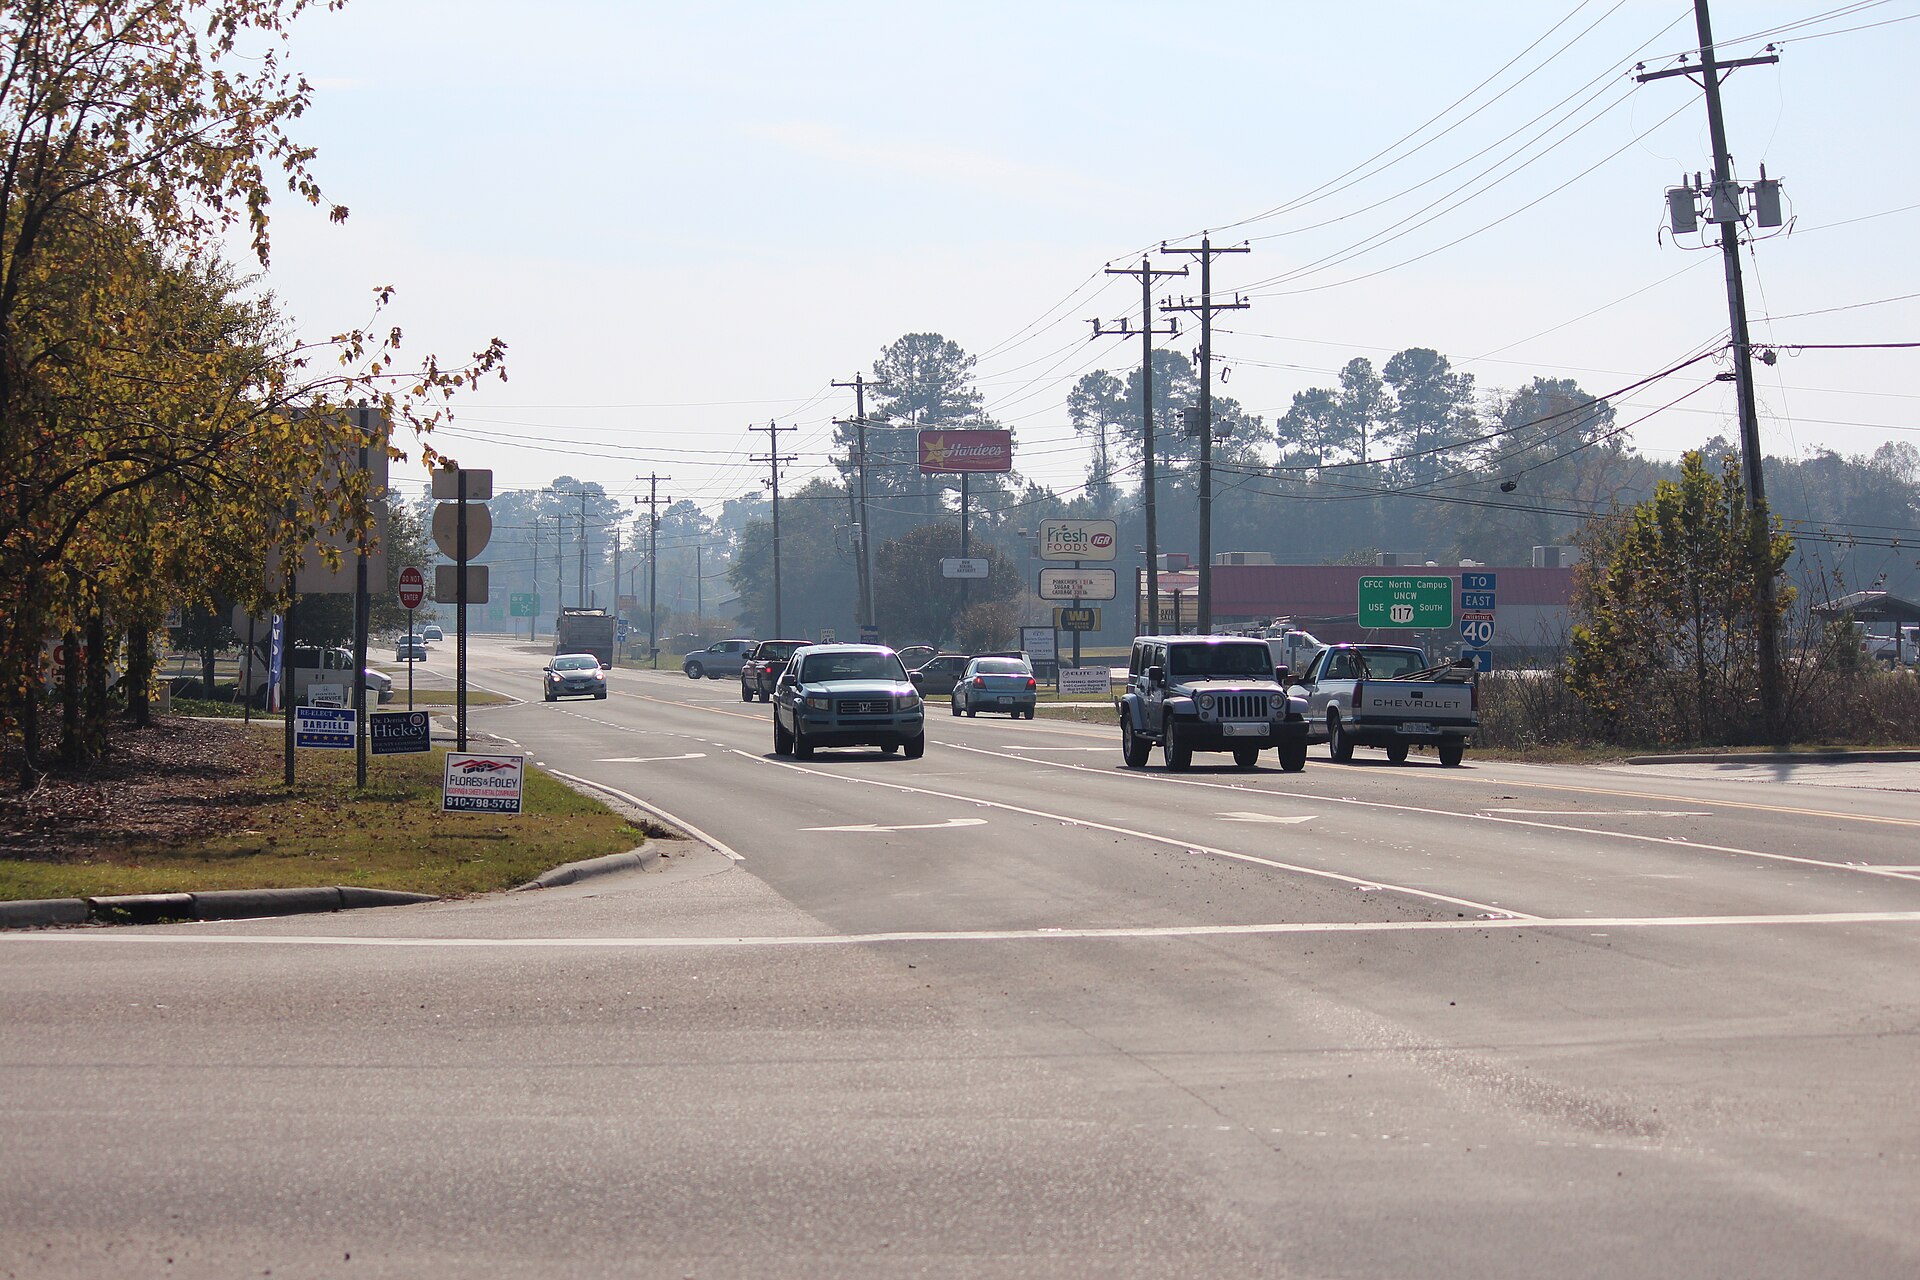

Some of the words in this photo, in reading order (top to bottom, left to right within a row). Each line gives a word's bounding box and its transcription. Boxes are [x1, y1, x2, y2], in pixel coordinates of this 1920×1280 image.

[1047, 527, 1088, 542] Fresh
[1093, 535, 1110, 545] IGA
[1047, 543, 1088, 551] FOODS
[1363, 580, 1384, 588] CFCC
[1388, 580, 1412, 588] North
[1416, 580, 1447, 590] Campus
[1470, 576, 1487, 587] TO
[1394, 592, 1417, 600] UNCW
[1465, 596, 1491, 606] EAST
[1069, 611, 1089, 621] WU
[1392, 607, 1412, 620] 117
[1462, 621, 1492, 641] 40
[1373, 699, 1460, 709] CHEVROLET
[300, 709, 333, 717] RE-ELECT
[303, 720, 349, 730] BARFIELD
[373, 724, 426, 740] Hickey
[449, 774, 482, 786] FLORES
[489, 776, 518, 788] FOLEY
[446, 797, 518, 809] 910-798-5762
